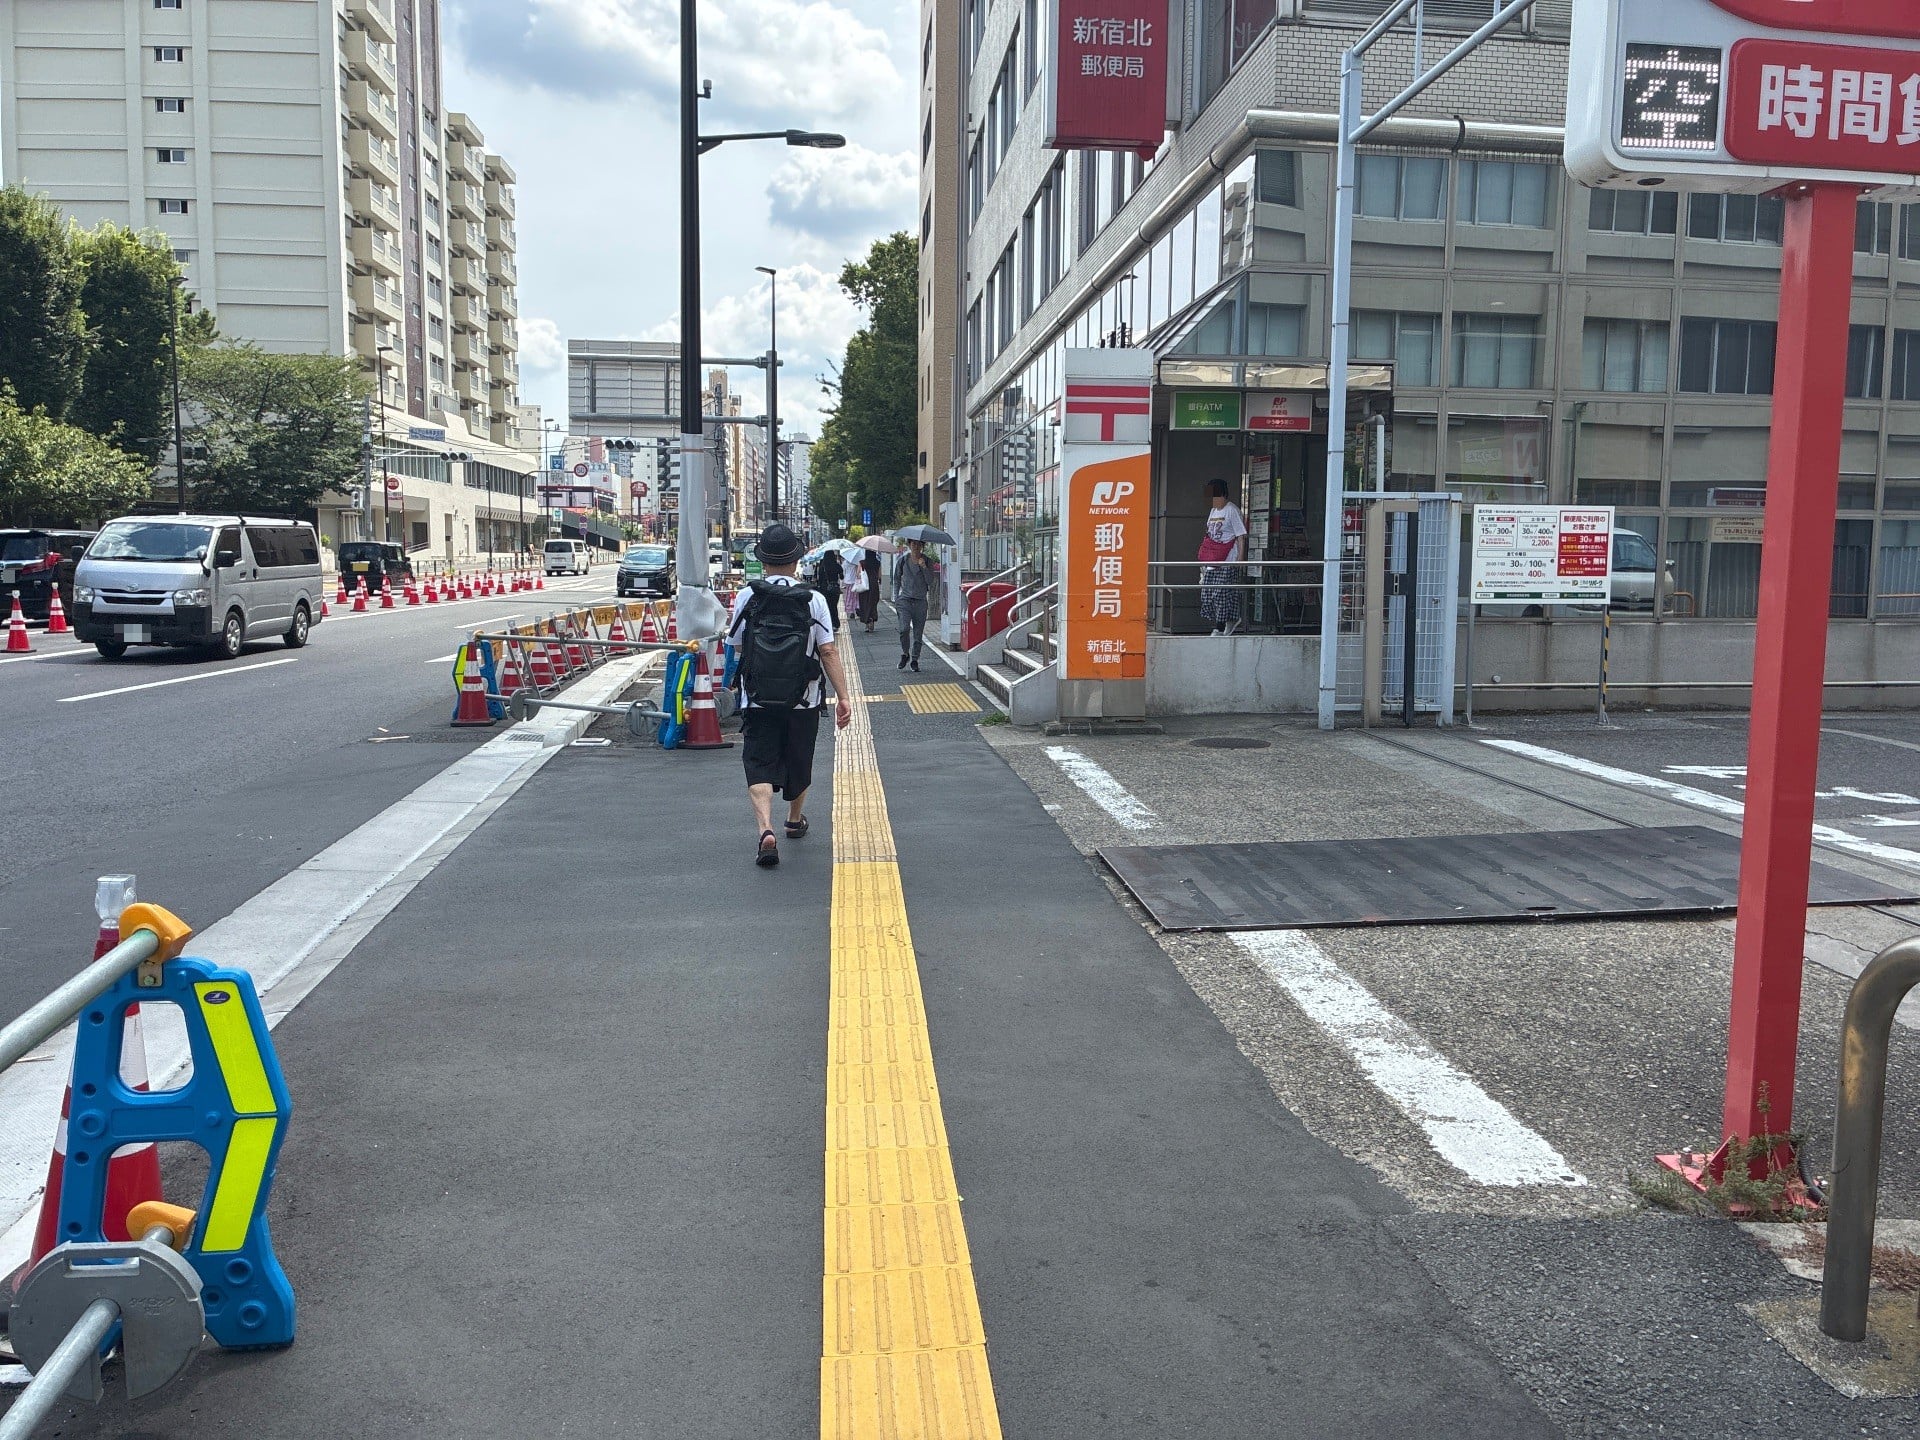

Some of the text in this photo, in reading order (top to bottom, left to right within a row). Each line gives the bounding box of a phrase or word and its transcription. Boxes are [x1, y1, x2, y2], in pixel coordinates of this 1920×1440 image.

[1073, 16, 1153, 47] 新宿北
[1081, 54, 1144, 78] 郵便局
[1621, 49, 1719, 150] 空
[1091, 481, 1135, 506] JP
[1089, 507, 1130, 515] NETWORK
[1563, 515, 1606, 523] 郵便局ご利用の
[1572, 523, 1597, 531] お客さま
[1091, 522, 1124, 618] 郵便局
[1086, 639, 1127, 653] 新宿北
[1092, 654, 1121, 664] 郵便局
